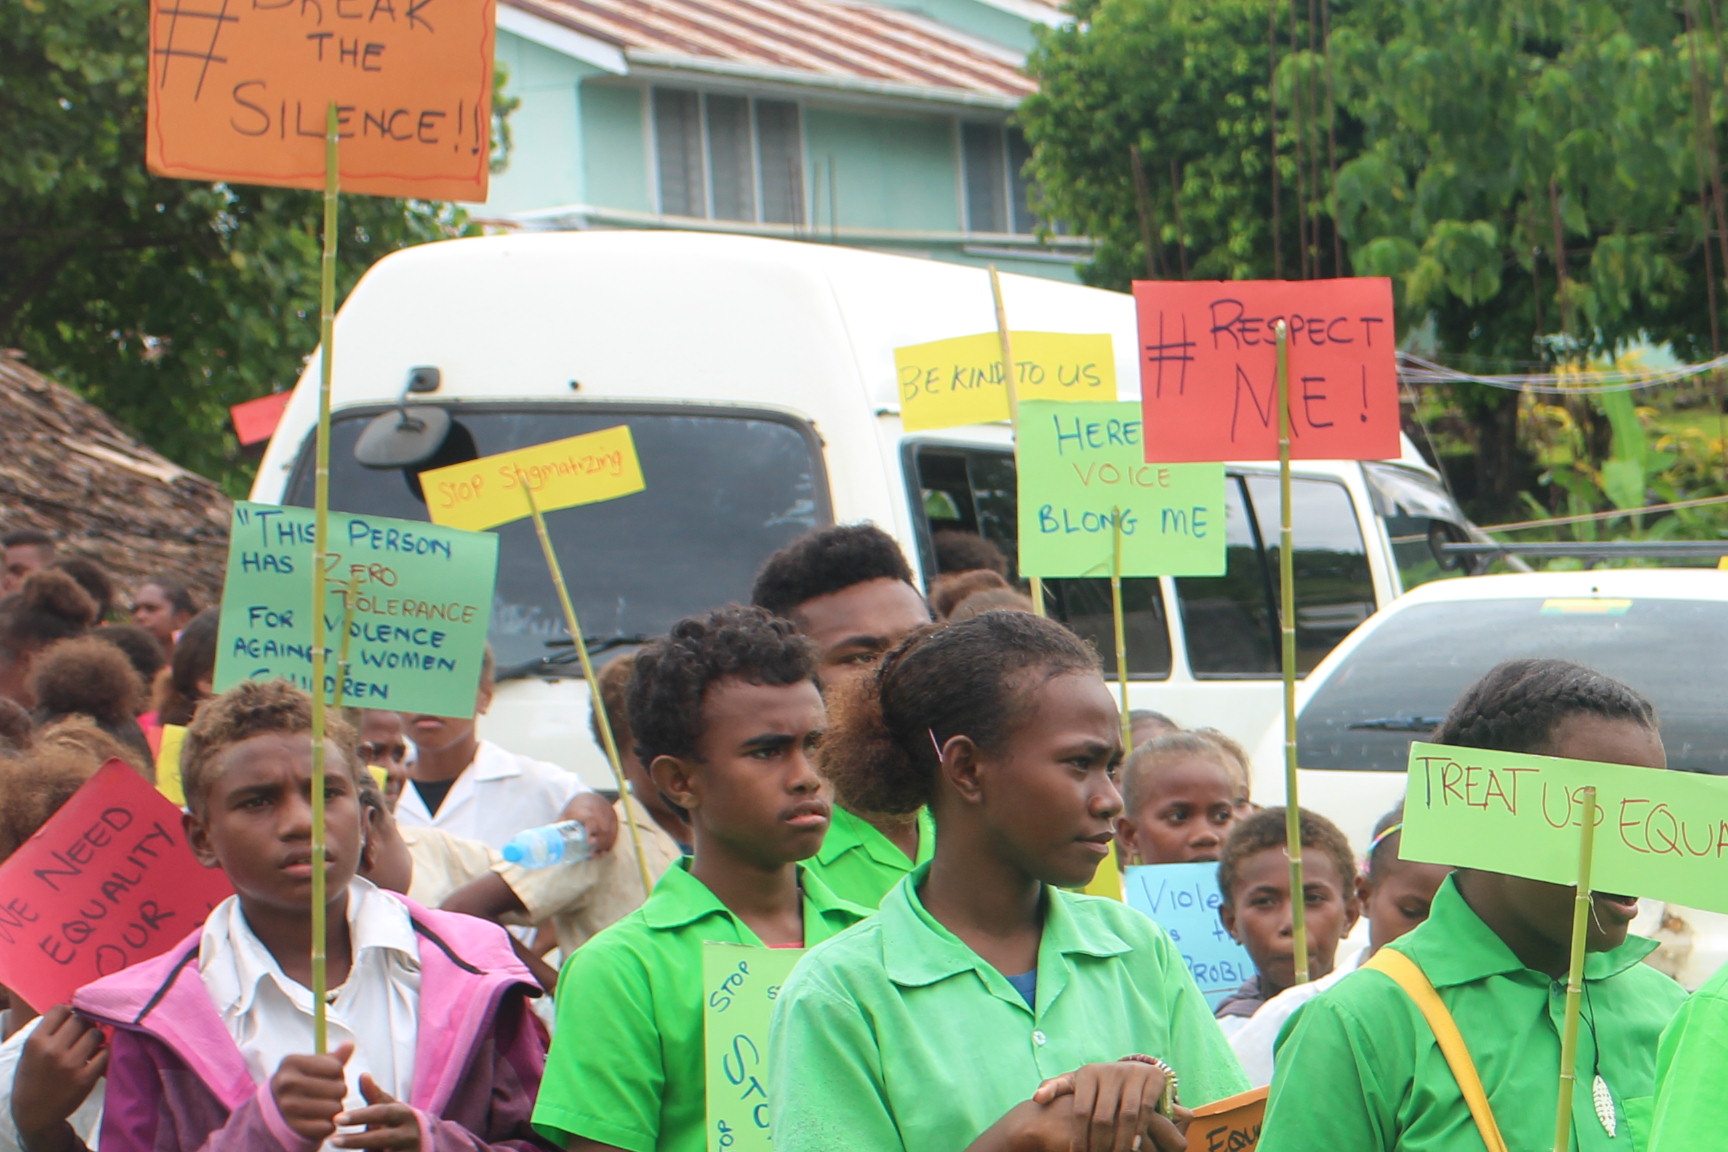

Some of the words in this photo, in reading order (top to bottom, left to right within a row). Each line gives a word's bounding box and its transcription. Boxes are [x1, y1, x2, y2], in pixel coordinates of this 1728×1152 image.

[307, 33, 386, 71] THE
[230, 80, 480, 156] SILENCE!!
[1146, 310, 1196, 398] #
[1209, 299, 1384, 350] RESPECT
[901, 365, 941, 401] BE
[951, 361, 1006, 389] KIND
[1017, 361, 1045, 385] TO
[1057, 362, 1102, 387] US
[437, 473, 485, 509] STOP
[1072, 462, 1172, 488] VOICE
[348, 519, 452, 560] PERSON
[1038, 503, 1138, 535] BLONG
[1162, 506, 1209, 538] ME
[241, 551, 294, 574] HAS
[323, 553, 399, 588] ZERO
[248, 606, 294, 629] FOR
[324, 614, 446, 649] VOLENCE
[330, 589, 479, 624] TOLERANCE
[361, 650, 456, 672] WOMEN
[1415, 757, 1540, 815] TREAT
[1542, 781, 1604, 828] US
[34, 807, 133, 891] NEED
[38, 822, 175, 965] EQUALITY
[95, 899, 176, 976] OUR
[709, 960, 750, 1013] STOP
[723, 1033, 771, 1140] STO
